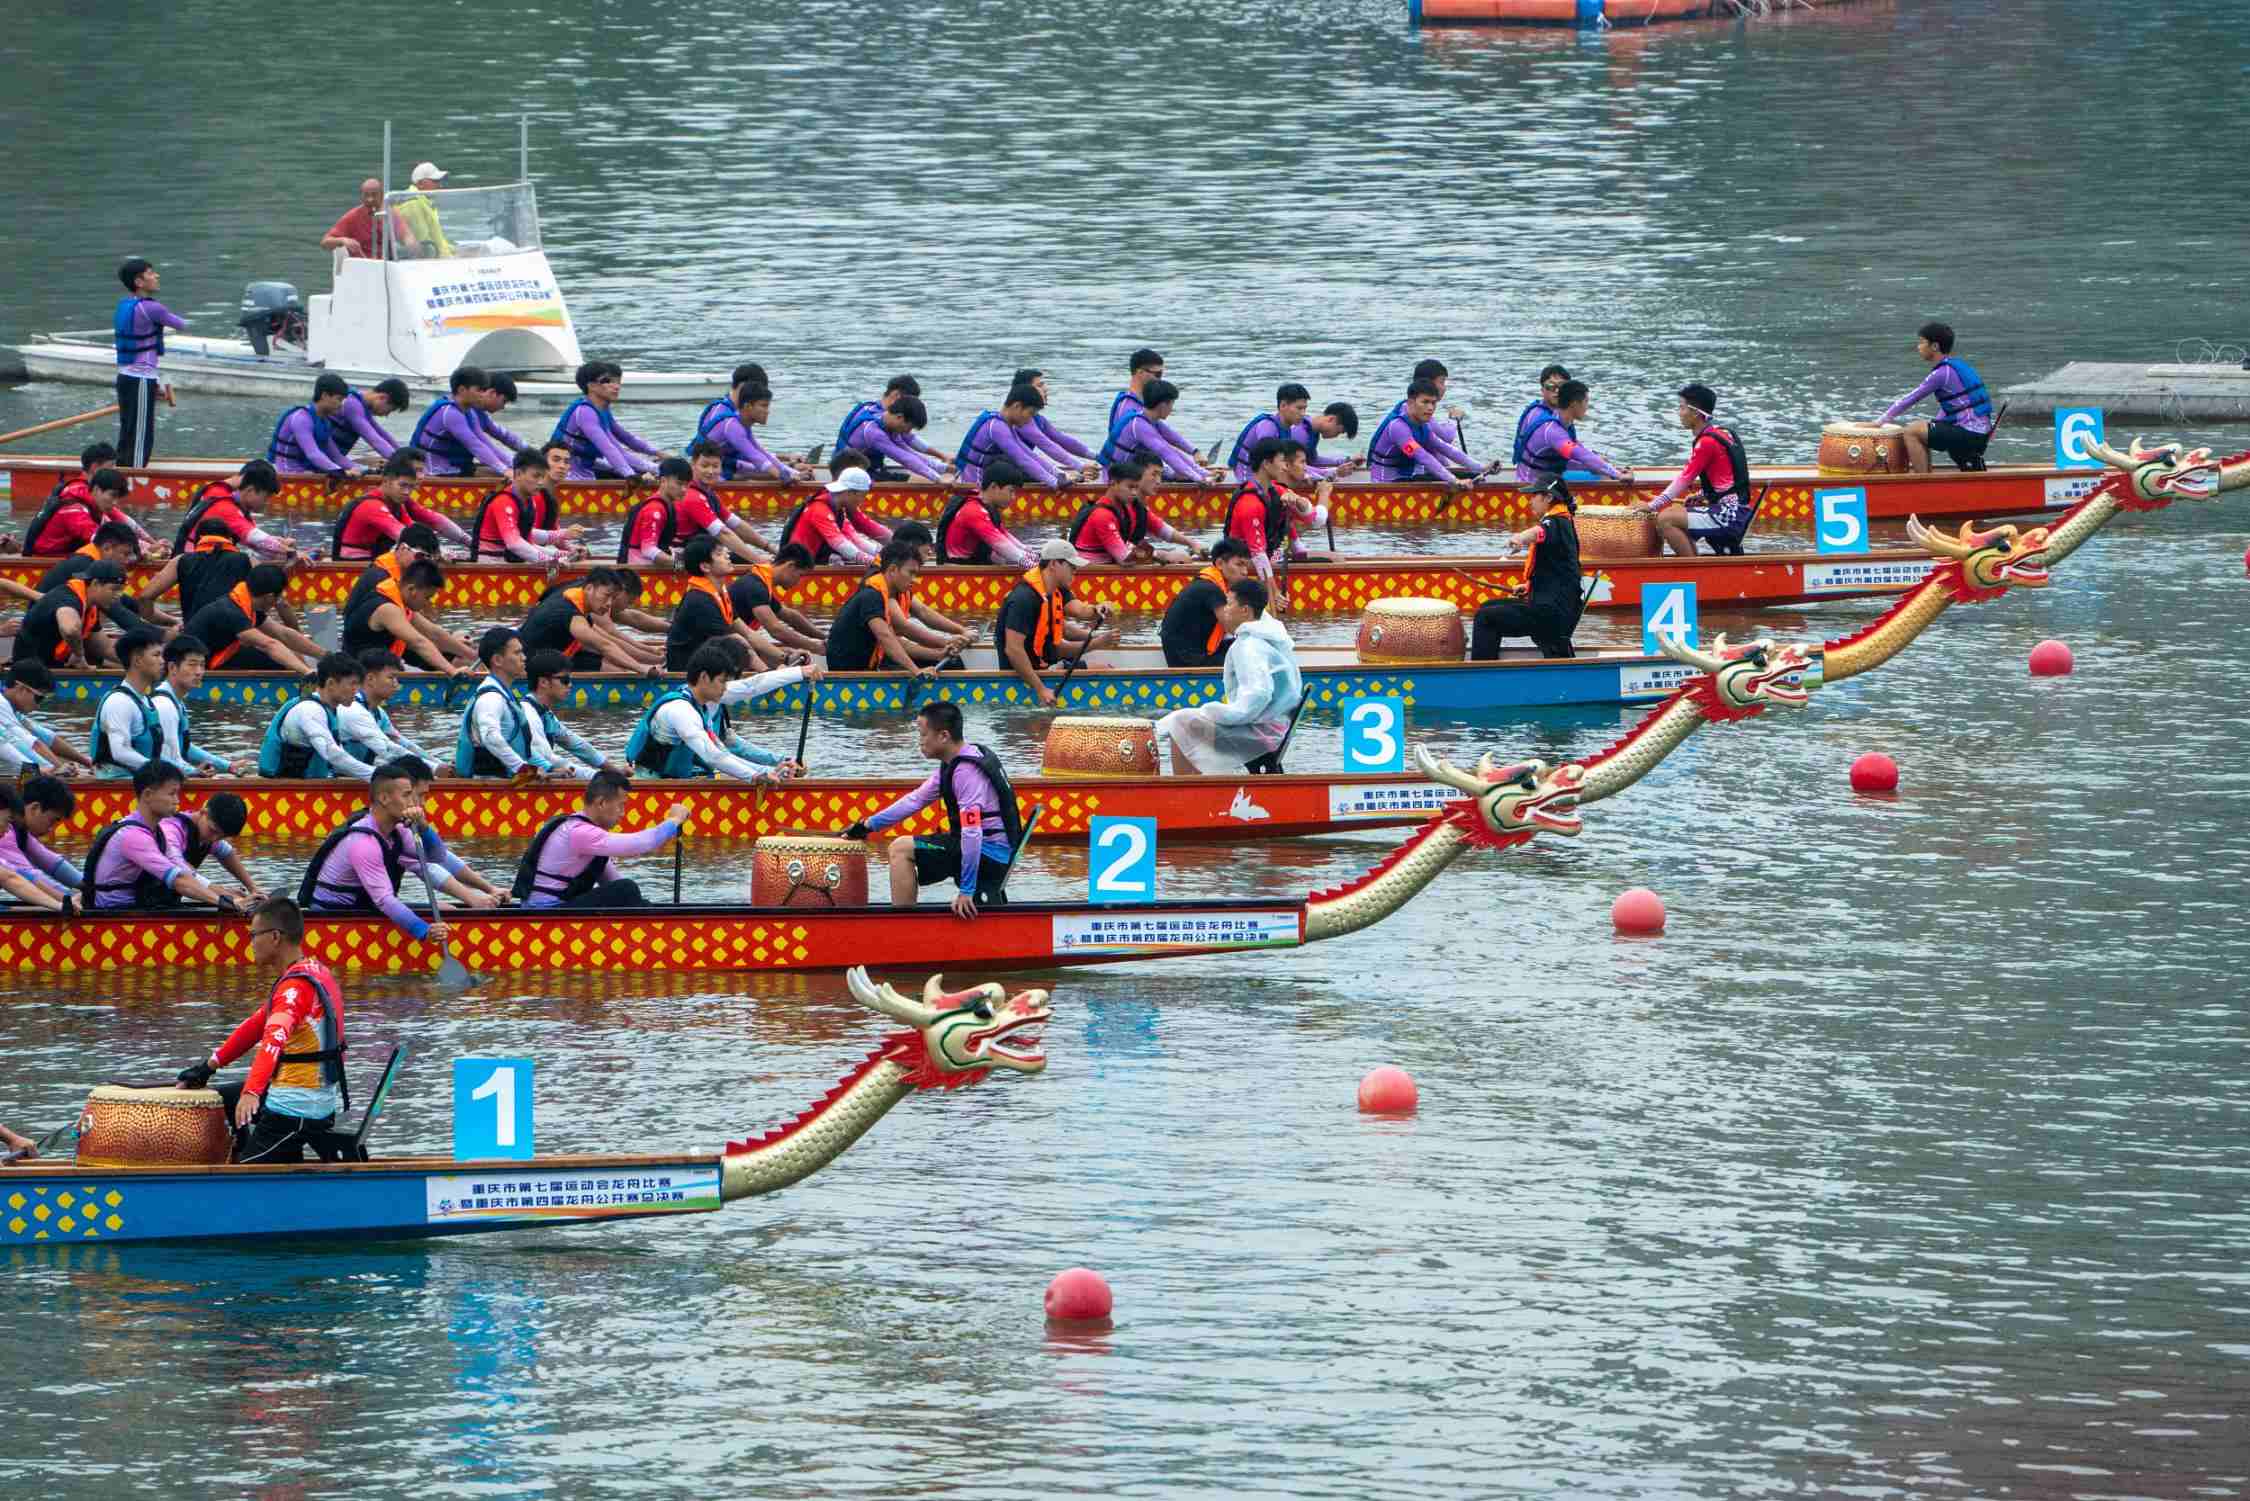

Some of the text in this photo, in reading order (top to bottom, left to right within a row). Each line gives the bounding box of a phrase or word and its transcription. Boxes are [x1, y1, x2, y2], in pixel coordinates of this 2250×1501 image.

[2061, 413, 2097, 461] 6
[1822, 494, 1860, 546] 5
[1648, 589, 1692, 644] 4
[1351, 703, 1397, 765] 3
[1097, 824, 1147, 891] 2
[472, 1067, 515, 1146] 1
[472, 1177, 672, 1195] 重庆市第七届运动会龙舟比赛
